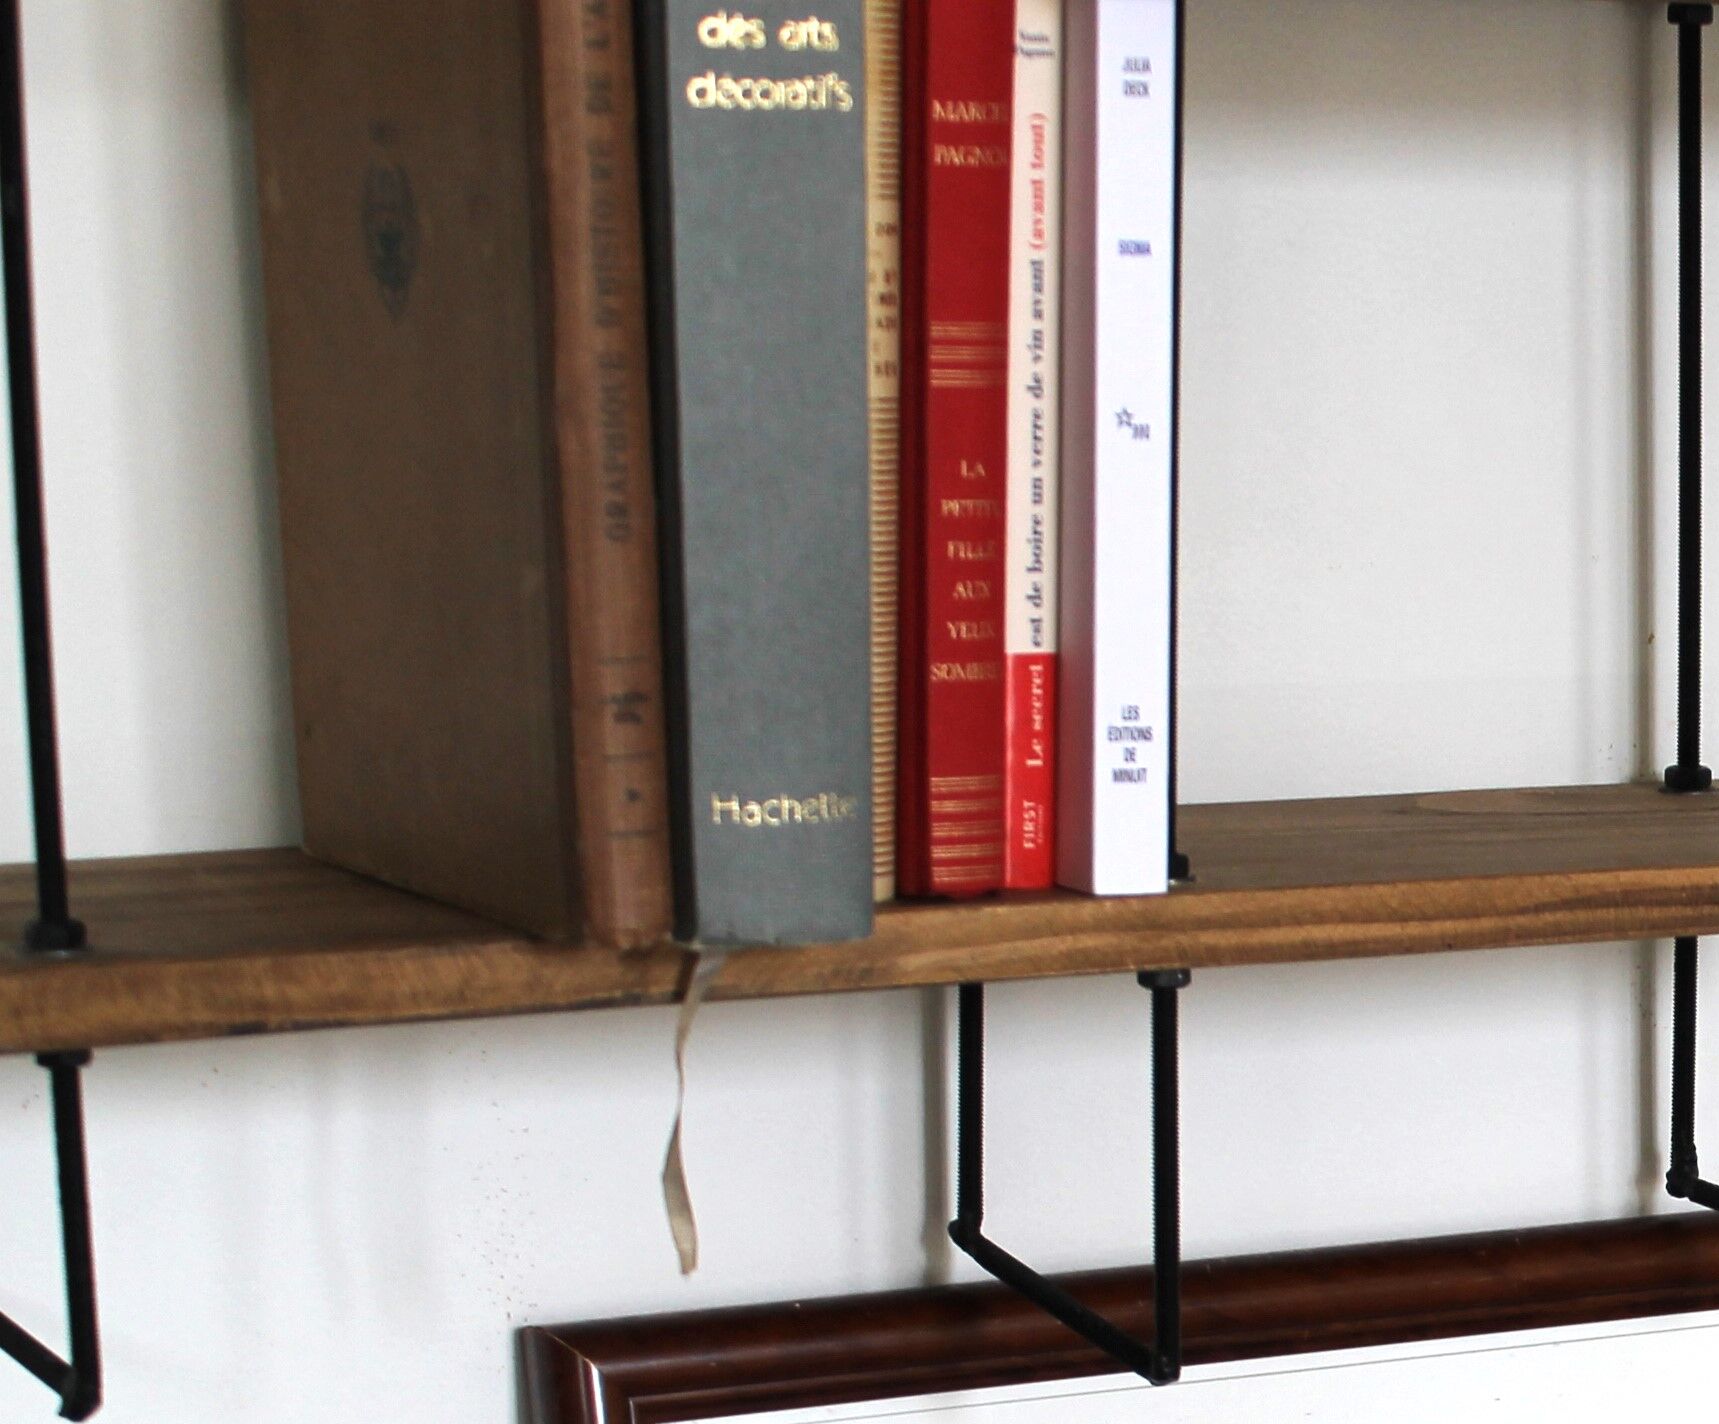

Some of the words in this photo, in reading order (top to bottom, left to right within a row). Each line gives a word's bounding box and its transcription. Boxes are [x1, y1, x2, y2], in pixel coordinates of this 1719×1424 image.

[1028, 112, 1048, 170] tout)
[1028, 178, 1048, 251] (avant
[1029, 258, 1044, 322] avant
[1026, 328, 1044, 365] vin
[1025, 372, 1044, 400] de
[1030, 406, 1043, 468] verre
[960, 459, 986, 478] LA
[1030, 476, 1043, 506] un
[1025, 513, 1043, 574] boire
[953, 580, 991, 599] AUX
[1025, 582, 1043, 609] de
[1028, 617, 1043, 648] est
[1028, 663, 1044, 731] secret
[1120, 704, 1140, 721] LES
[1025, 738, 1044, 768] Le
[1123, 746, 1137, 763] DE
[1111, 767, 1147, 784] MINUIT
[1023, 800, 1036, 849] FIRST
